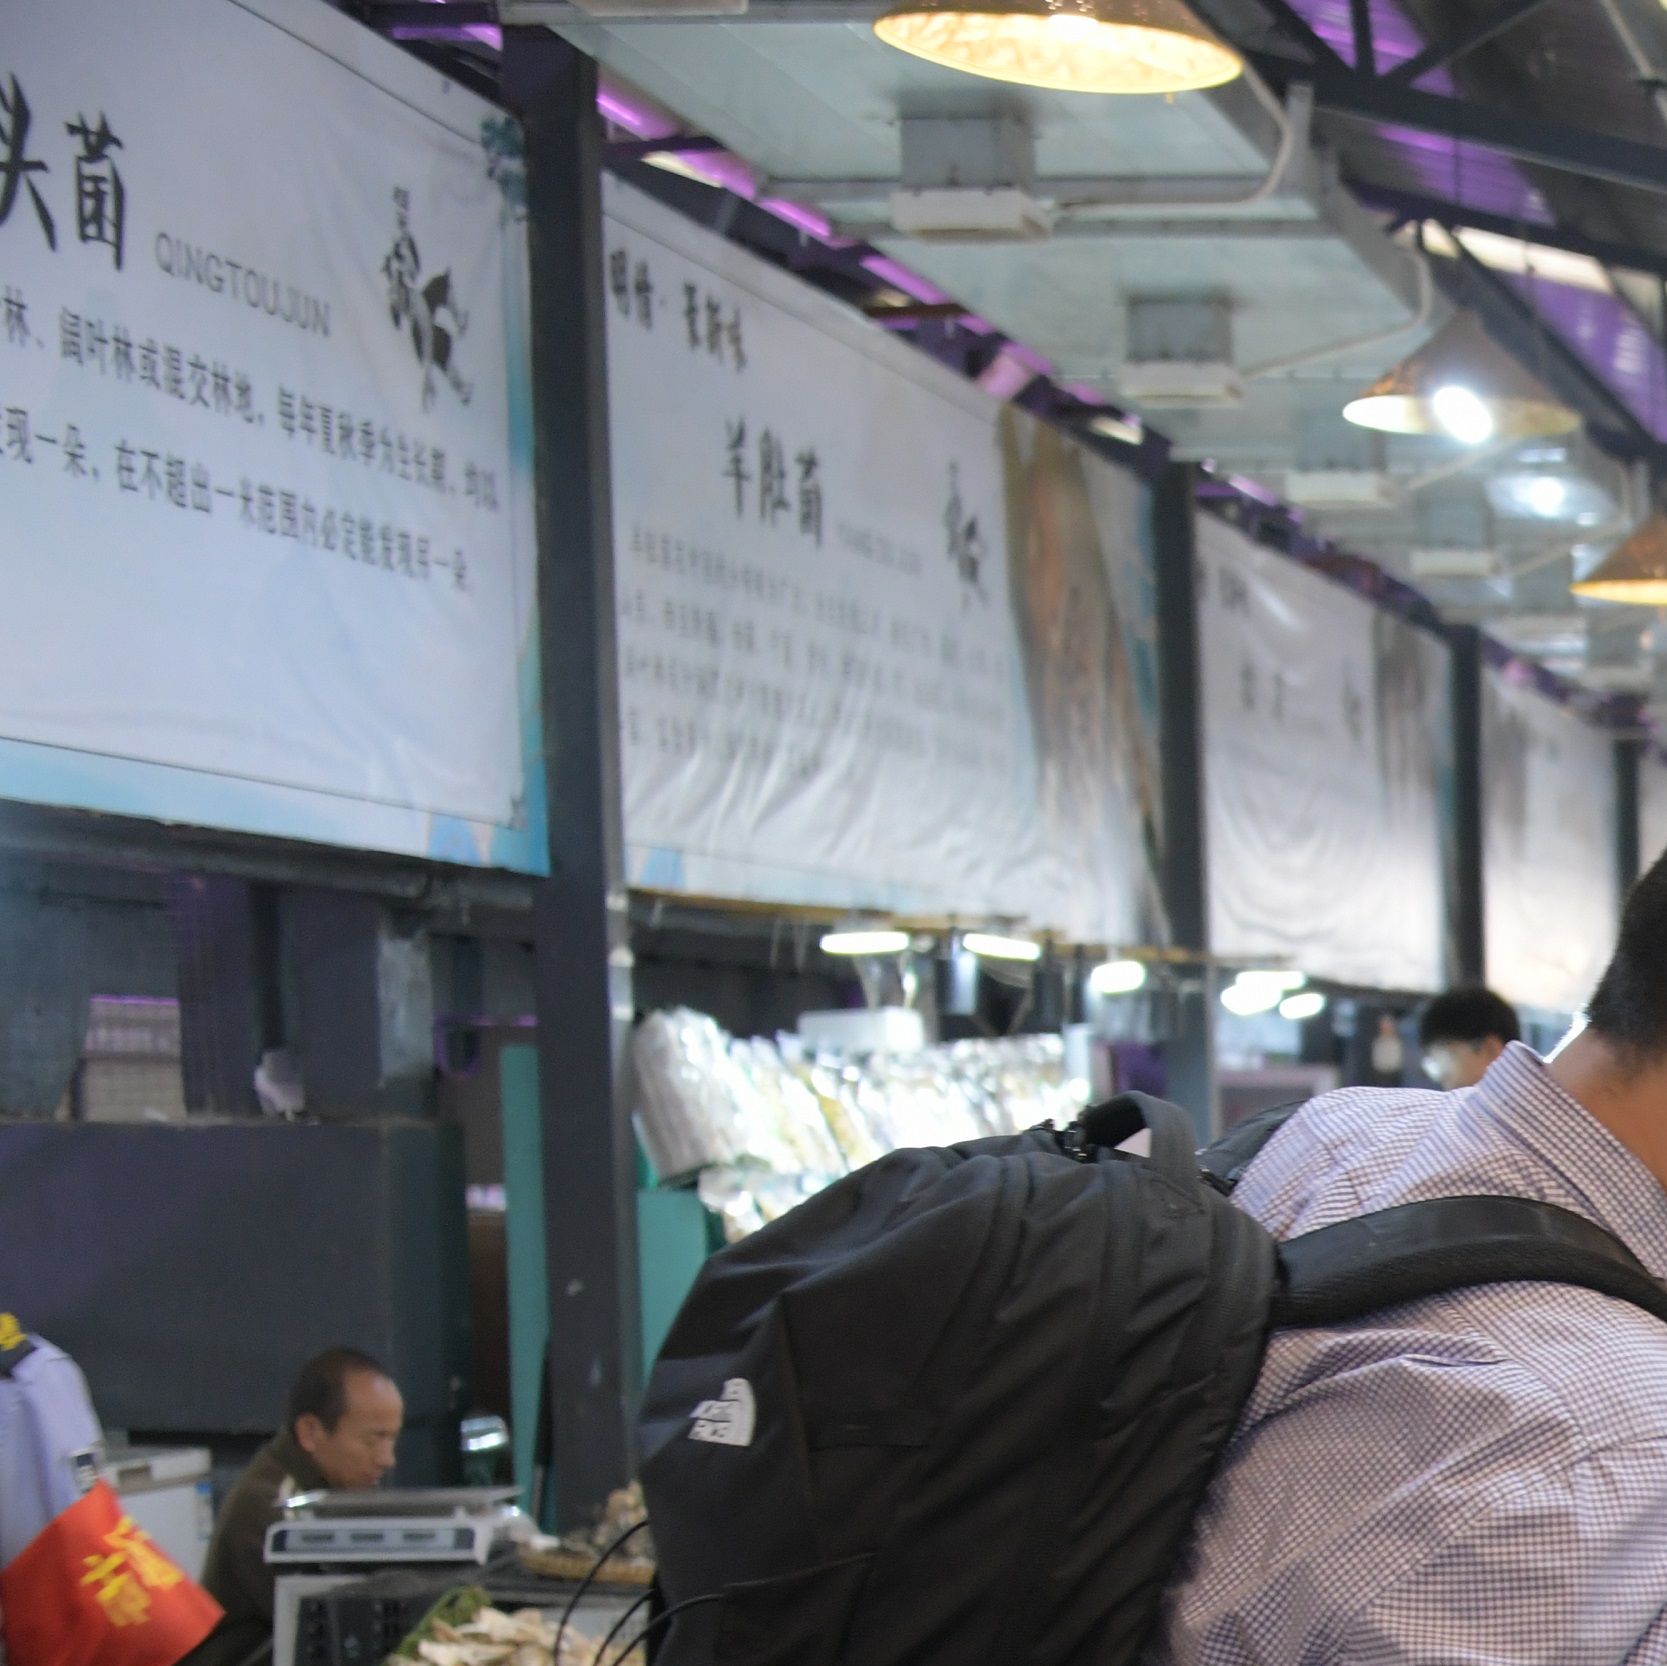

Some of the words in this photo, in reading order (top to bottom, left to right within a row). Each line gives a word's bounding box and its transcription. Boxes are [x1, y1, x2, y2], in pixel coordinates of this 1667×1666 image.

[154, 231, 331, 338] QINGTOUJUN
[723, 411, 824, 550] 羊肚菌
